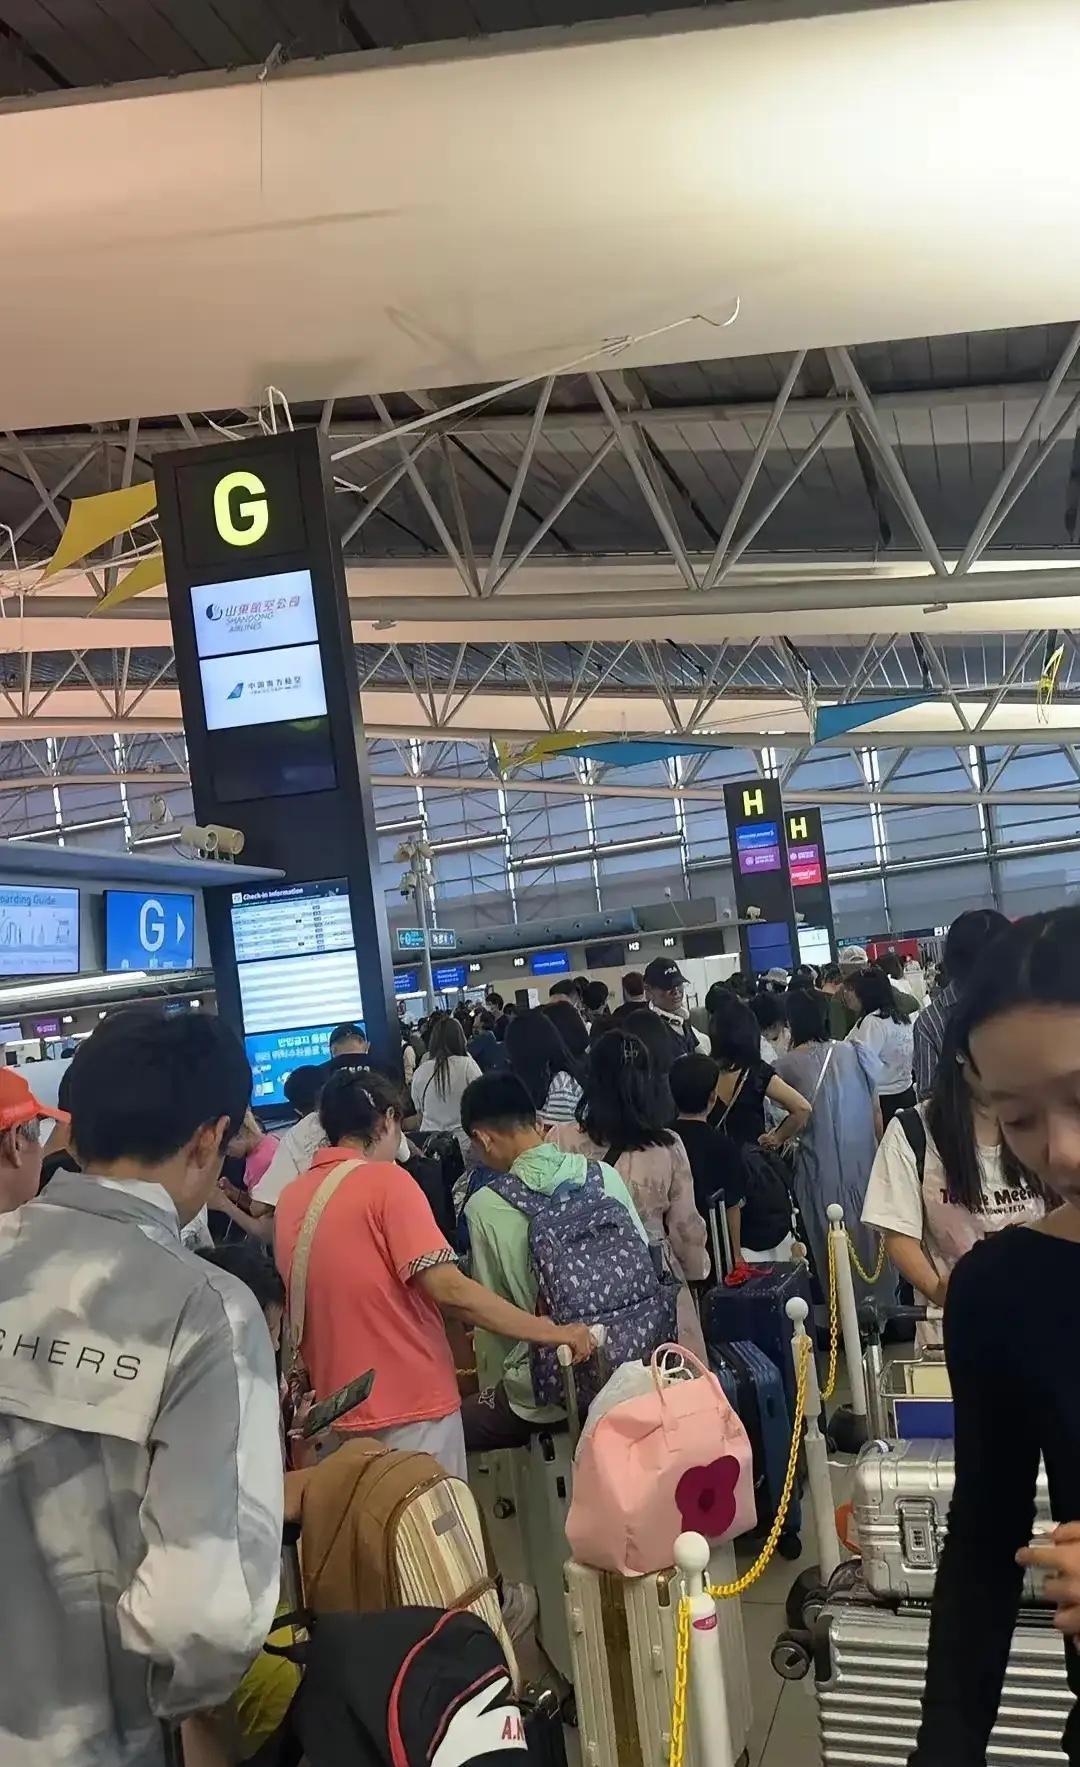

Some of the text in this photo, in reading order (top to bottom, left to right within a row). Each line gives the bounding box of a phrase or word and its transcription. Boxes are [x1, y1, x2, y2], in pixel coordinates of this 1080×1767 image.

[213, 471, 269, 546] G
[226, 612, 275, 625] SHANDONG
[228, 622, 263, 633] AIRLINES
[742, 788, 764, 816] H
[790, 816, 808, 839] H
[33, 894, 57, 905] Guide
[138, 898, 166, 953] G
